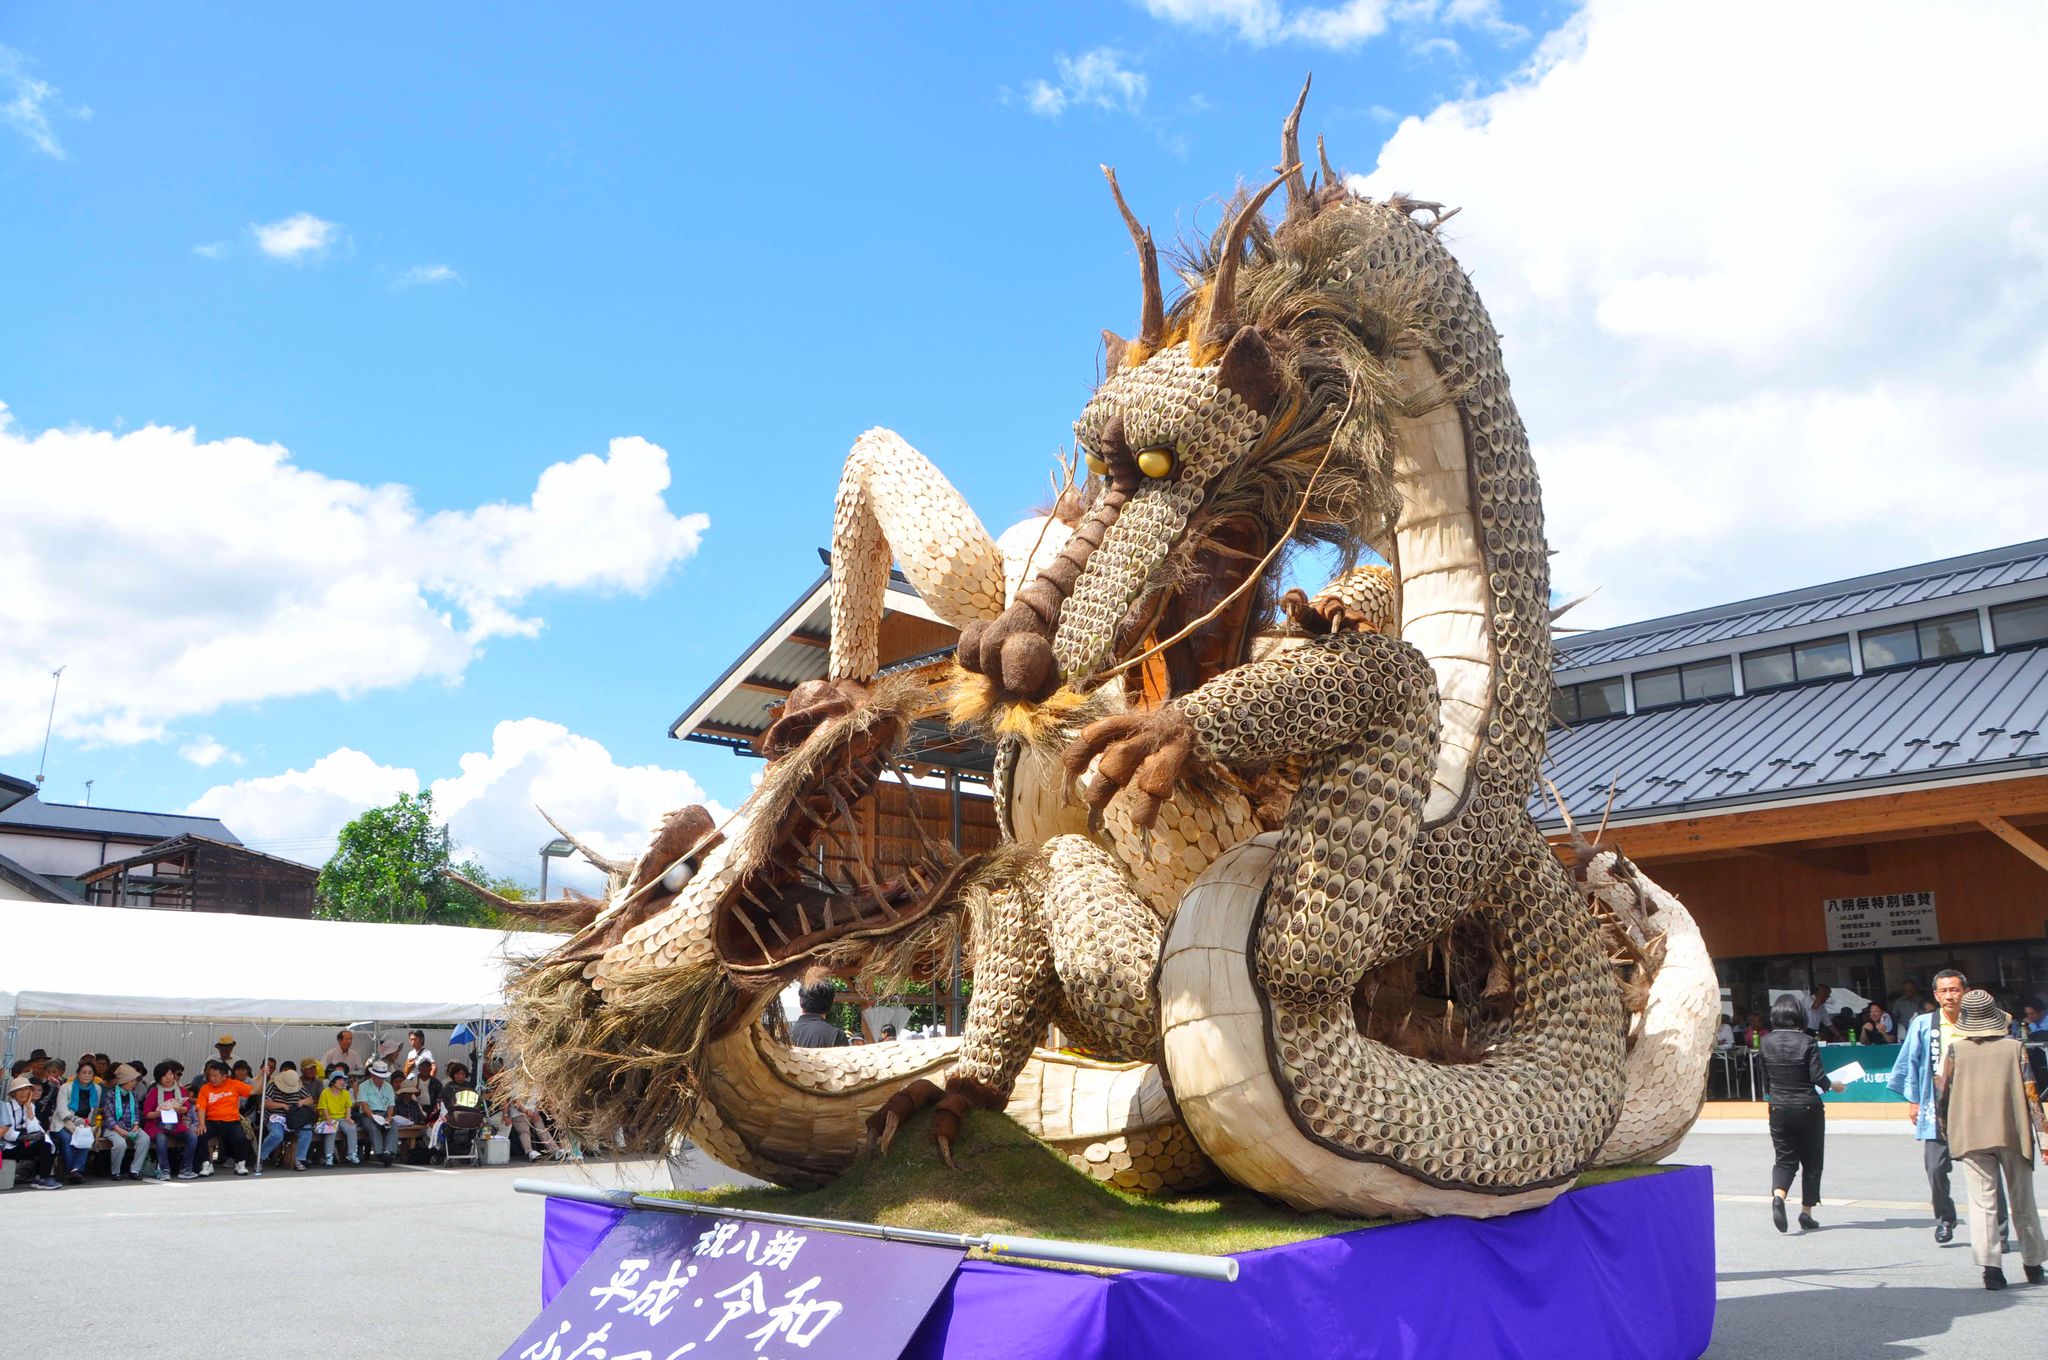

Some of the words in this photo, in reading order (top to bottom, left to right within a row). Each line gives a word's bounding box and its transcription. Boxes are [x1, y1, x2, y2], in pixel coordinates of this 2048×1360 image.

[1828, 893, 1931, 912] 八朔祭特別協賛
[693, 1222, 807, 1270] 祝八朔
[590, 1259, 843, 1351] 平成・令和
